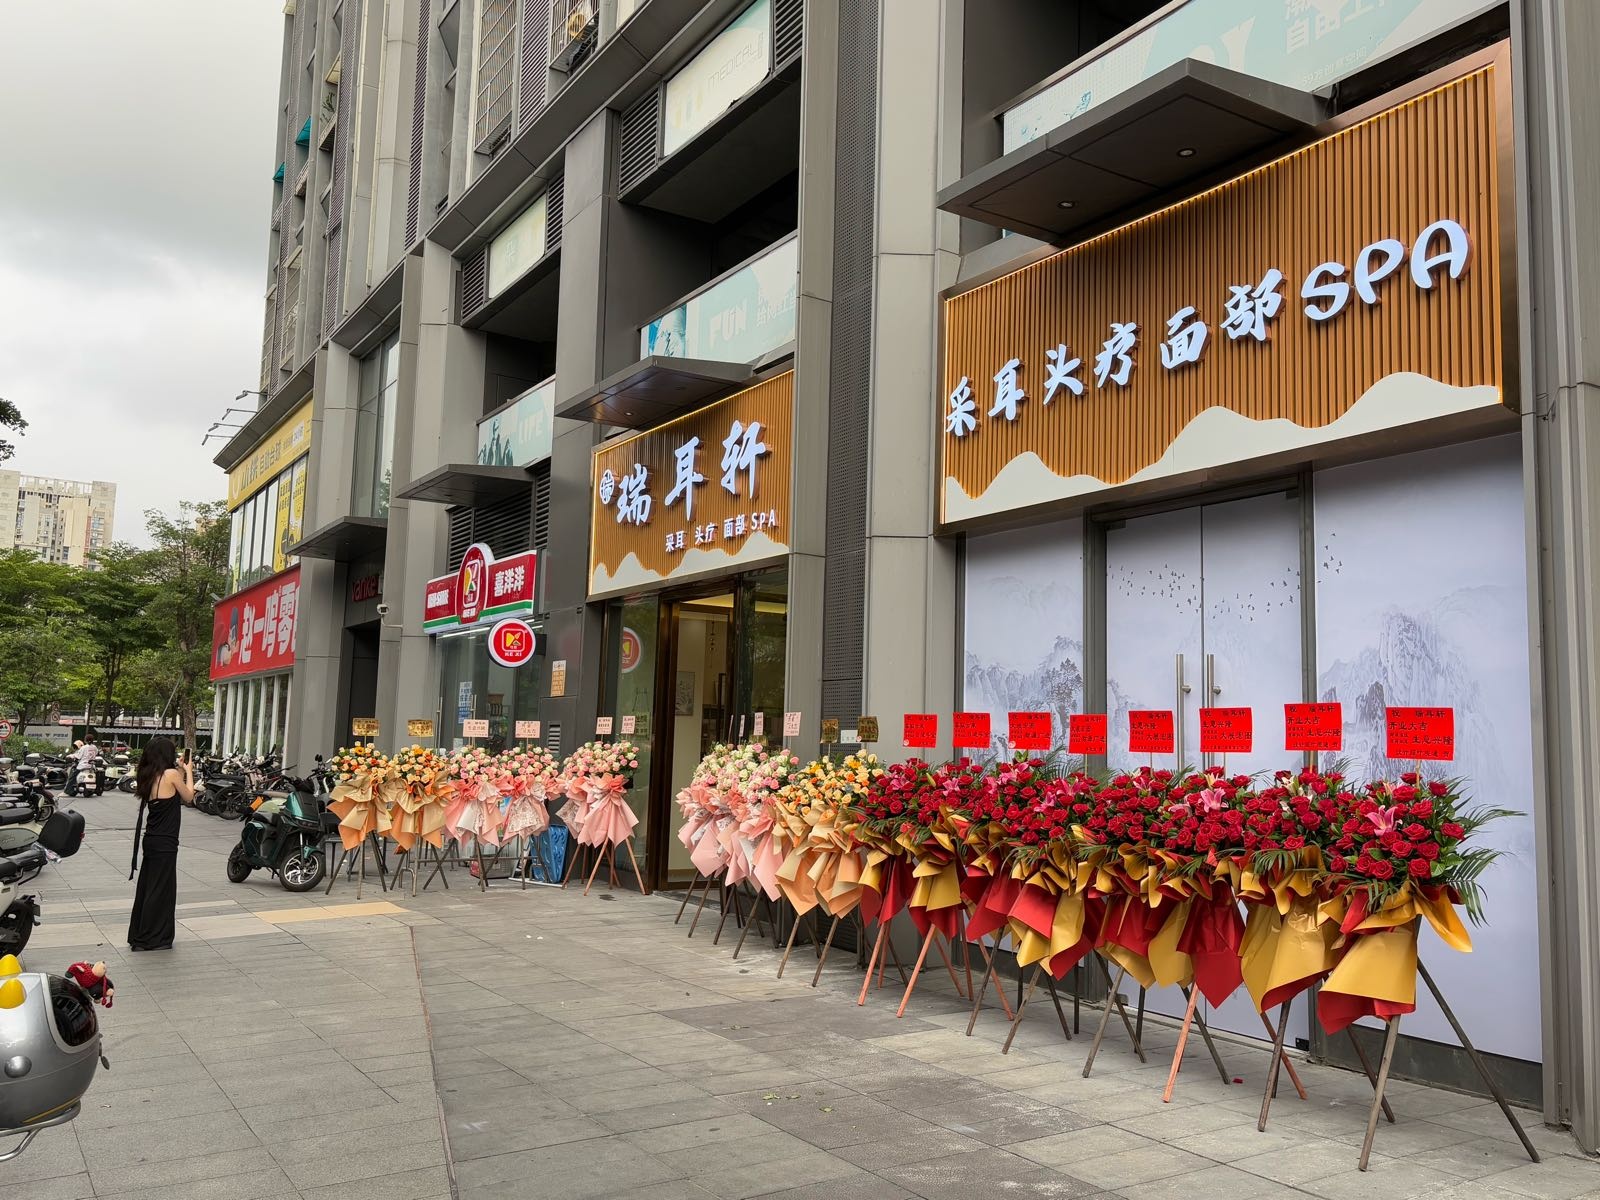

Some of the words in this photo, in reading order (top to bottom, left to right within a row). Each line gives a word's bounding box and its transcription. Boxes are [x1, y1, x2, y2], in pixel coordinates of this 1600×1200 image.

[617, 419, 767, 526] 瑞耳轩
[666, 531, 685, 553] 采耳
[695, 522, 718, 545] 头疗
[724, 515, 746, 539] 面部
[751, 509, 777, 530] SPA
[494, 565, 525, 597] 喜洋洋
[1287, 716, 1320, 725] 开业大吉
[1389, 721, 1428, 731] 开业大吉
[1411, 735, 1453, 745] 生意兴隆
